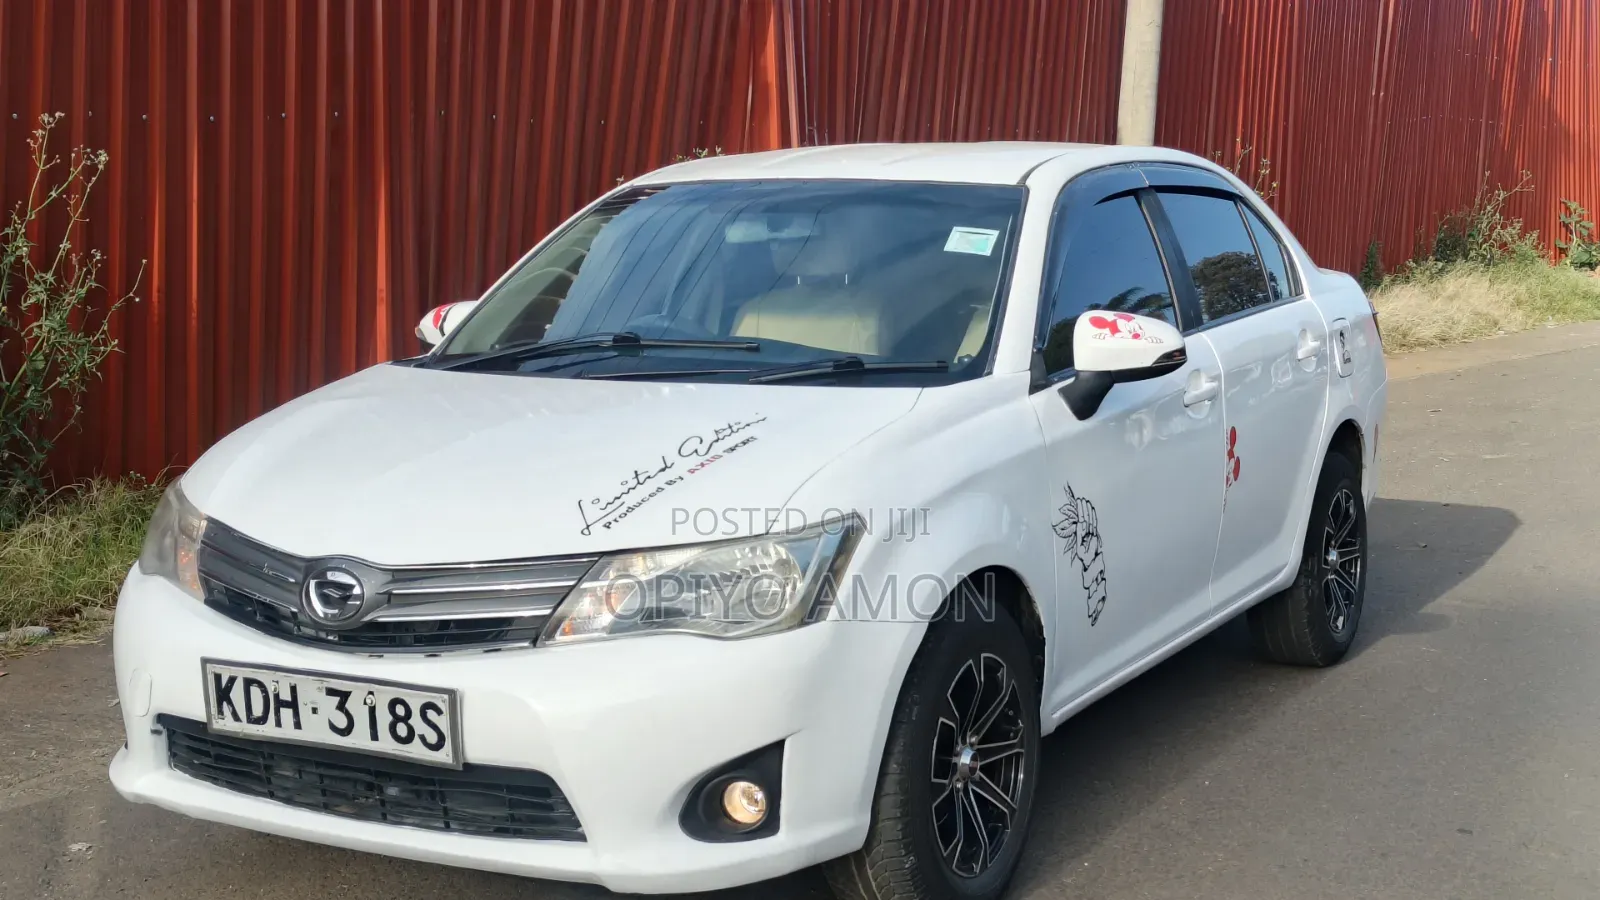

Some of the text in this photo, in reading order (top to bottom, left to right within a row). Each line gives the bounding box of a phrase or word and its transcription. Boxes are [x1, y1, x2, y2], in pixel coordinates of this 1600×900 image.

[578, 455, 675, 536] Limited
[602, 436, 758, 529] Produced By AXIO SPORT
